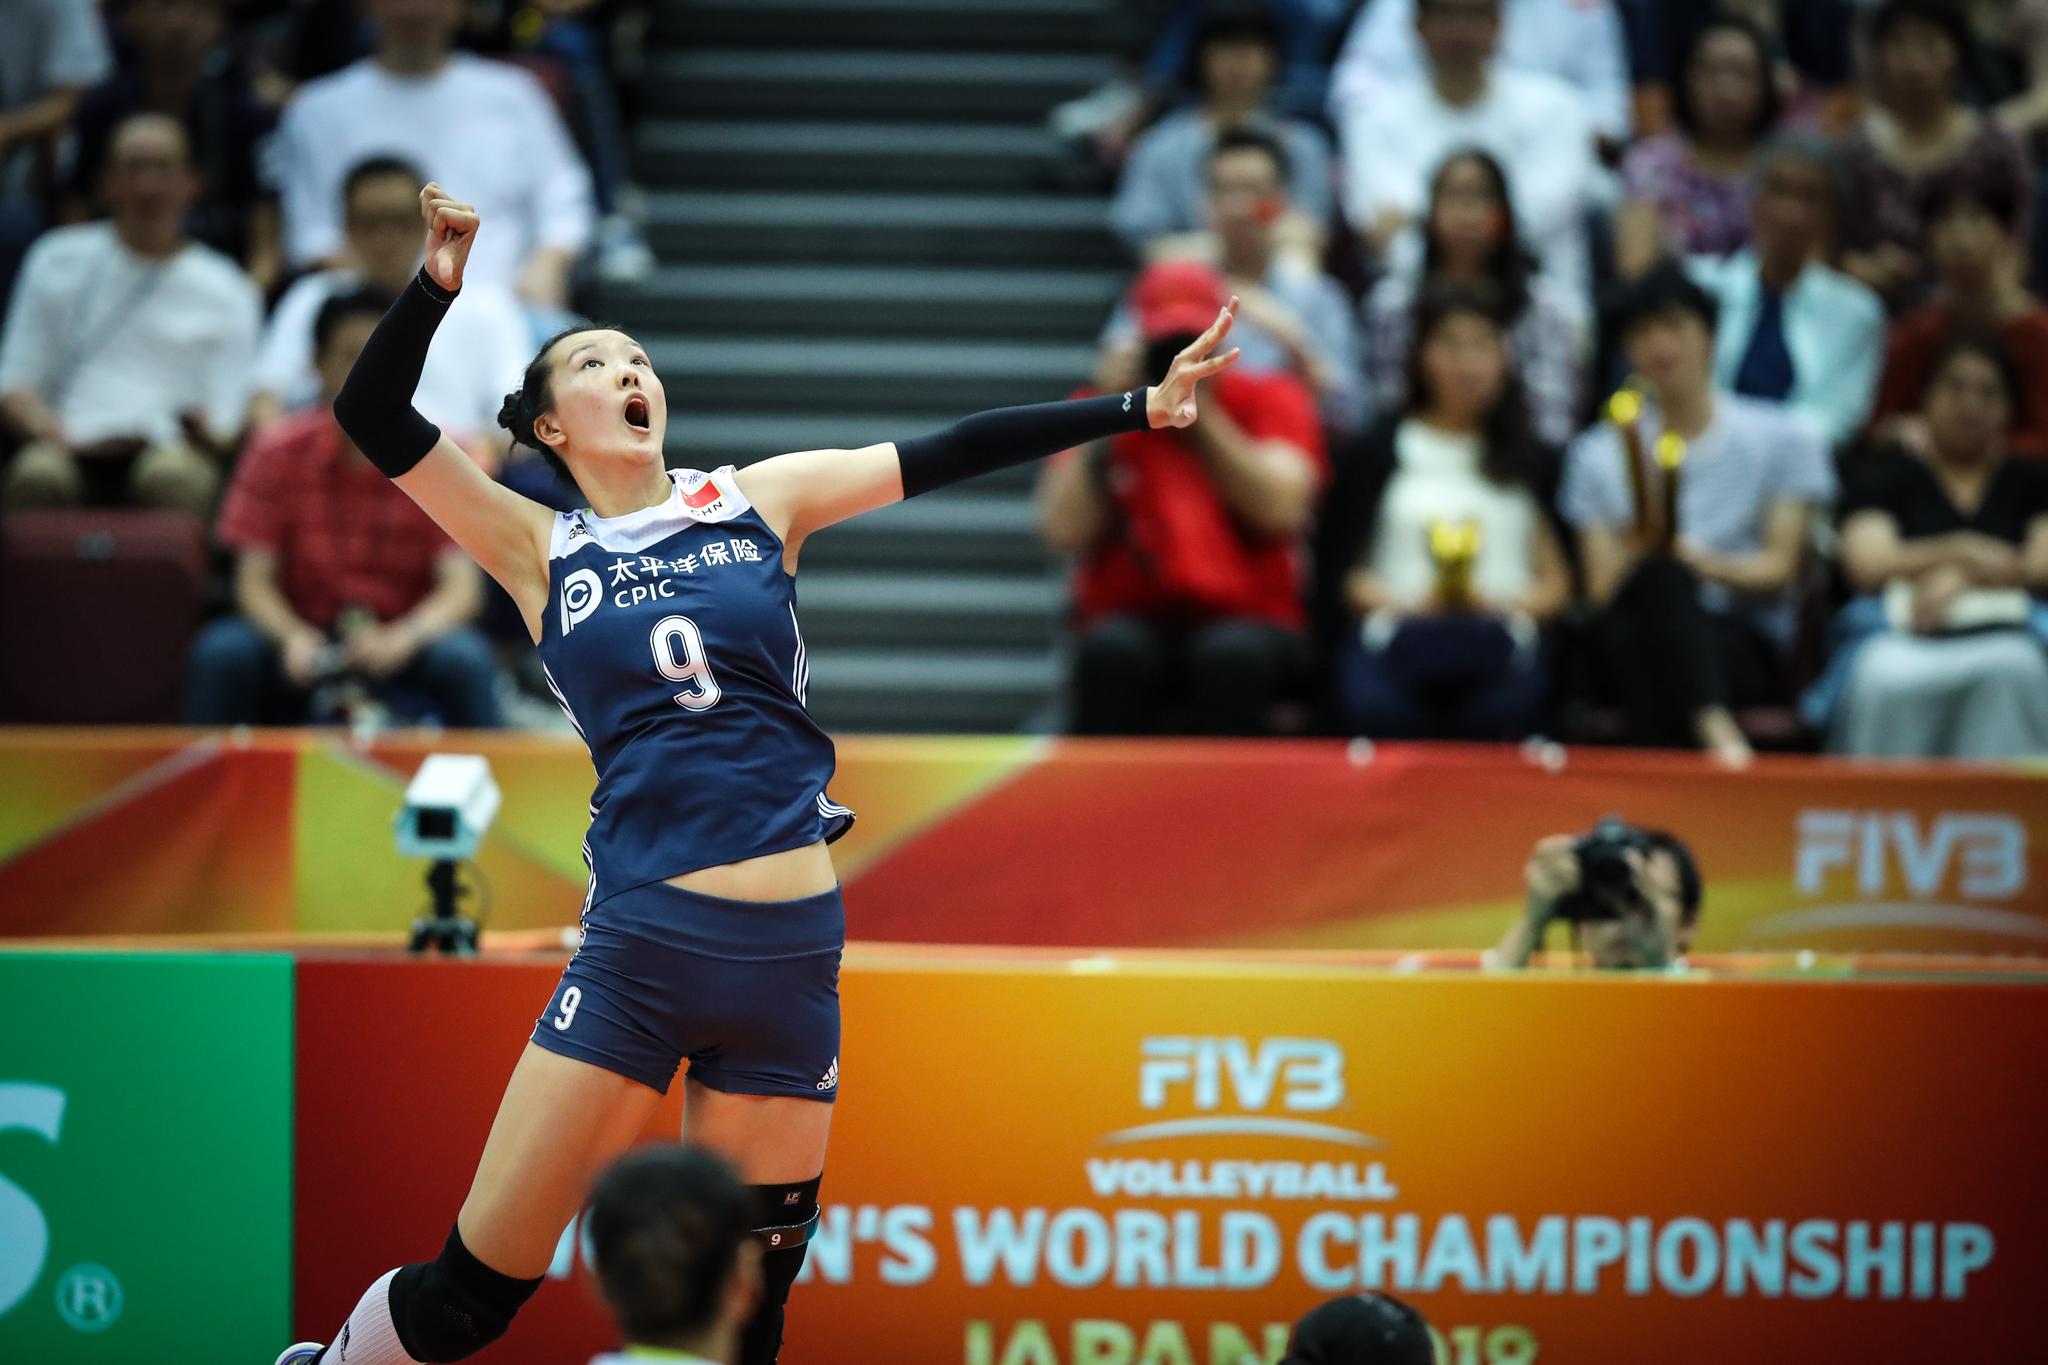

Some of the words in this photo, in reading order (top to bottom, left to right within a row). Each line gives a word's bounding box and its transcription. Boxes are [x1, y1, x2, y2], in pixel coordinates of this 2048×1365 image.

[690, 501, 723, 516] CHN
[607, 538, 763, 588] 太平洋保险
[614, 578, 676, 608] CPIC
[650, 614, 722, 712] 9
[1794, 808, 2027, 898] FIVB
[554, 985, 582, 1031] 9
[1140, 1035, 1345, 1111] FIVB
[1086, 1159, 1397, 1200] VOLLEYBALL
[770, 1233, 782, 1246] 9
[953, 1206, 1282, 1289] WORLD
[1298, 1211, 1996, 1300] CHAMPIONSHIP
